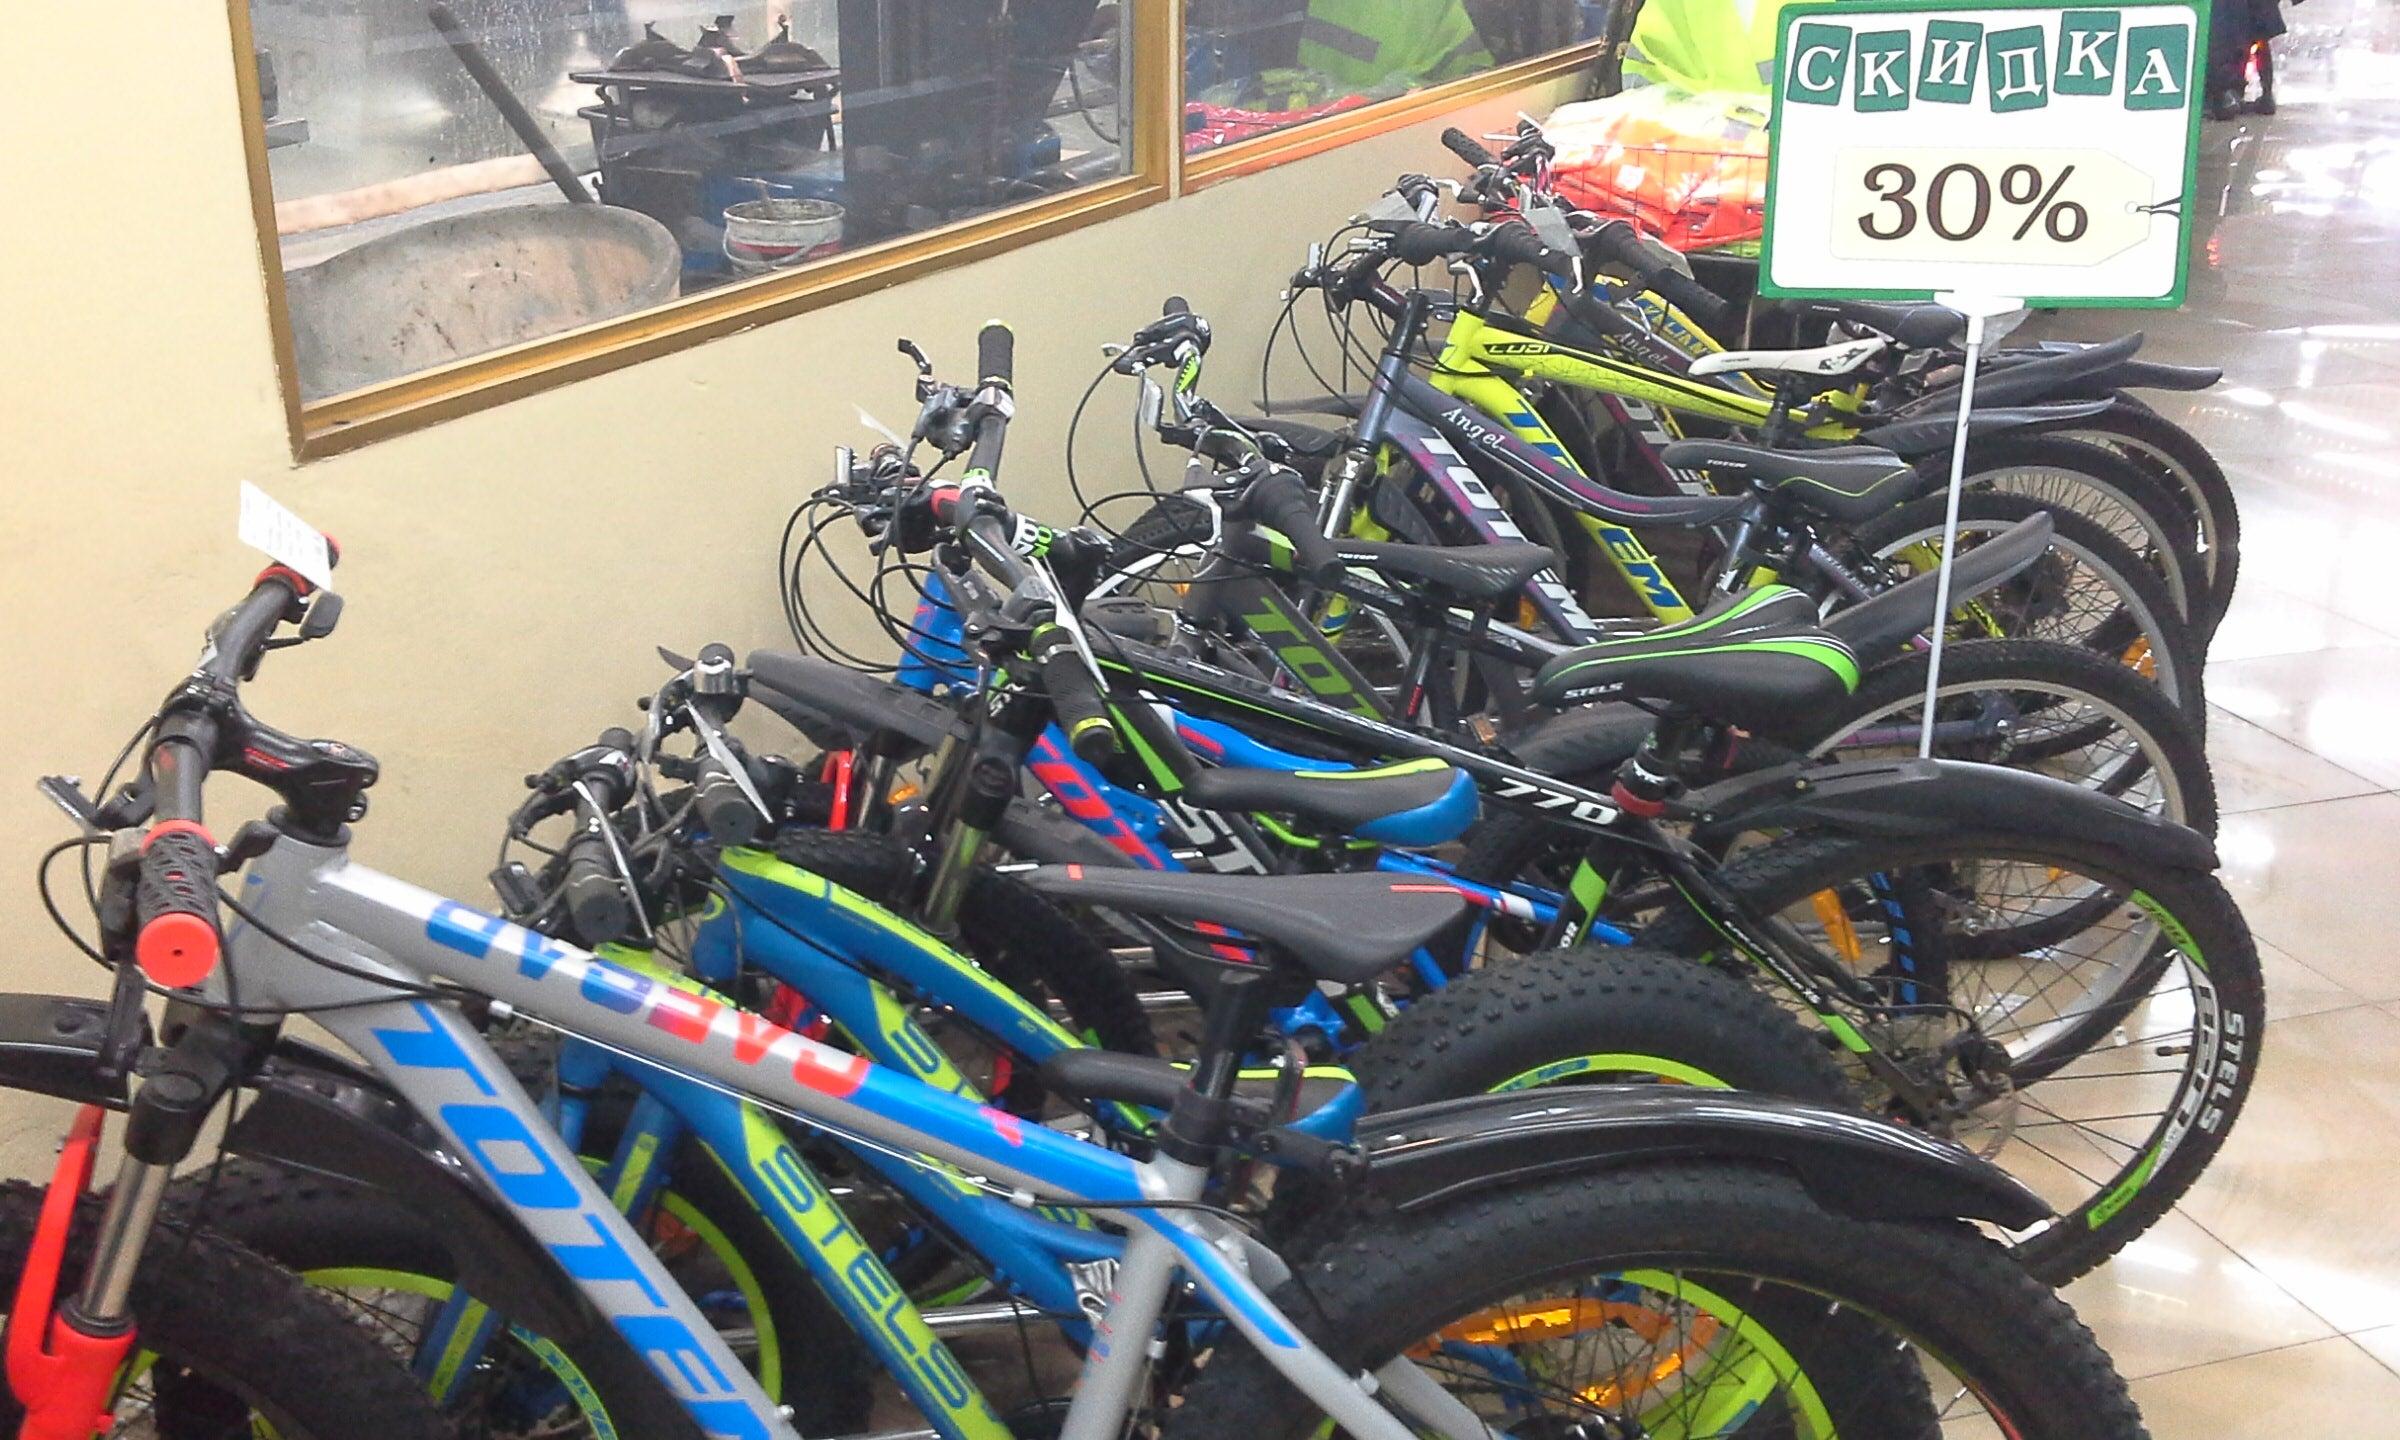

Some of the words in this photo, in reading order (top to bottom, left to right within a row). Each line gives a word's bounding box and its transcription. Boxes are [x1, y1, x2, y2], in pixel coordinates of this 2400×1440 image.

[1798, 30, 2181, 101] СКИДКА
[1857, 163, 2089, 242] 30%
[1441, 407, 1507, 450] Angel
[1563, 682, 1624, 699] STELS
[1494, 777, 1618, 826] 770
[2197, 1009, 2246, 1134] STELS
[759, 1144, 980, 1411] STELS
